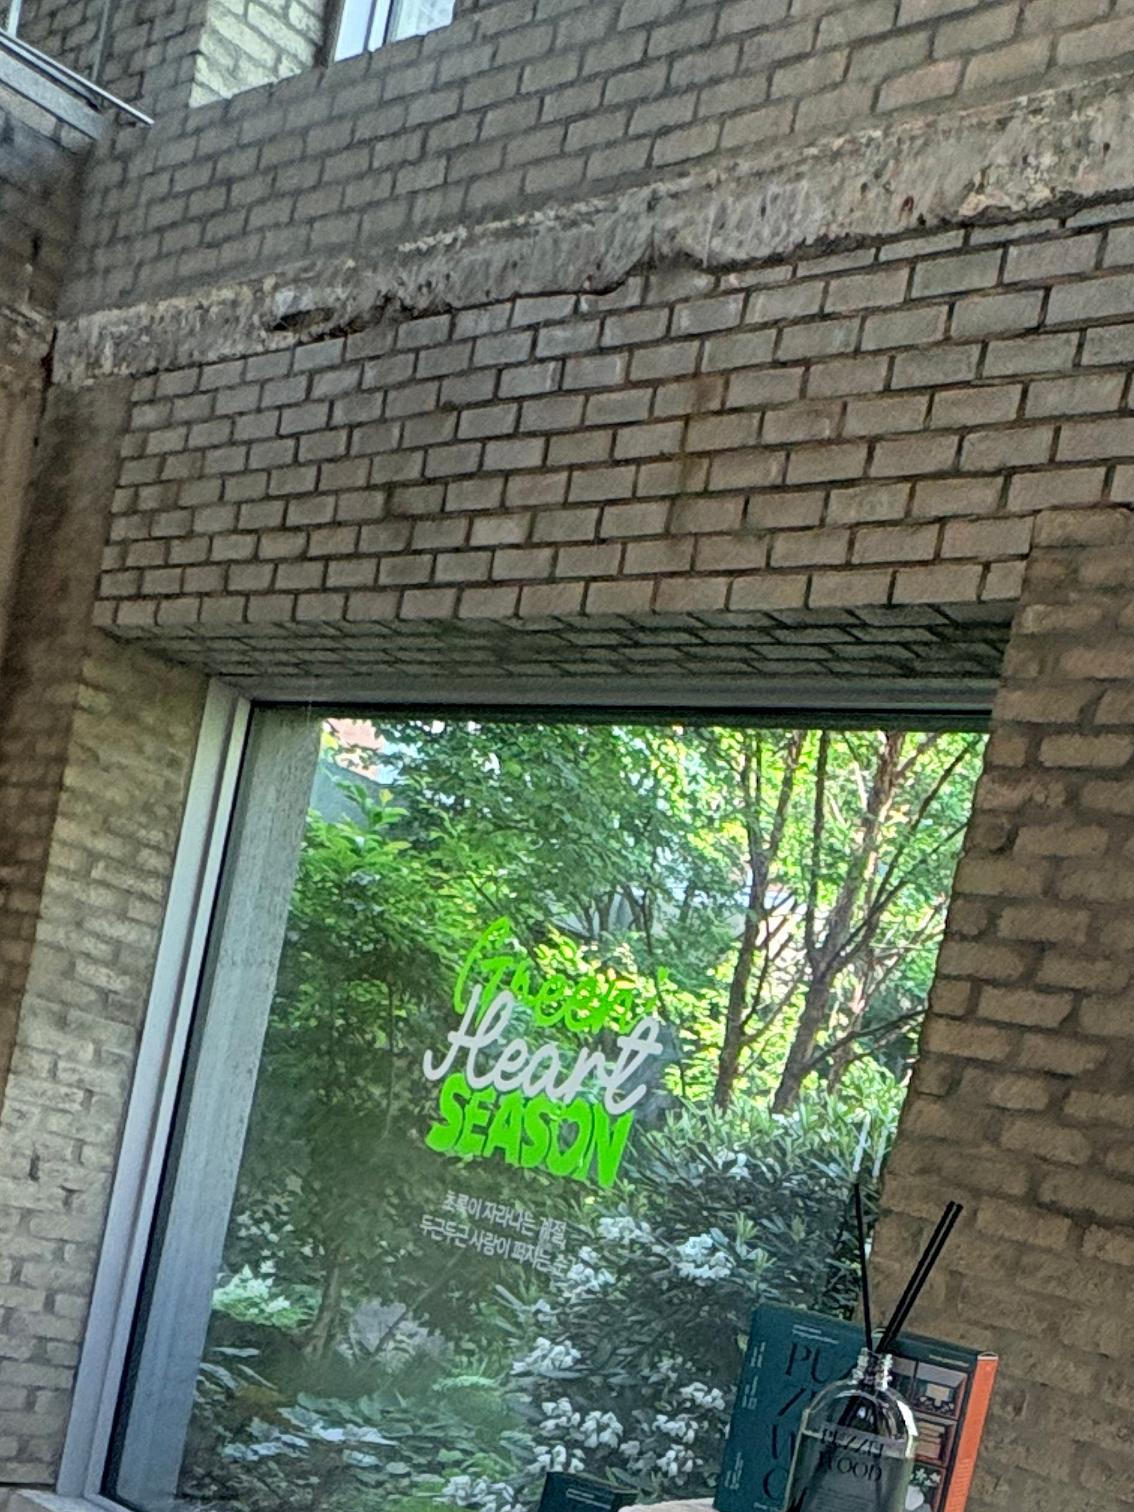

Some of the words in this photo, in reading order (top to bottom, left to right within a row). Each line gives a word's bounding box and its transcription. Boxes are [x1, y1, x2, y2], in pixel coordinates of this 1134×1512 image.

[422, 983, 664, 1115] Heart
[424, 1071, 635, 1188] SEASON
[416, 1213, 470, 1250] 두근두근
